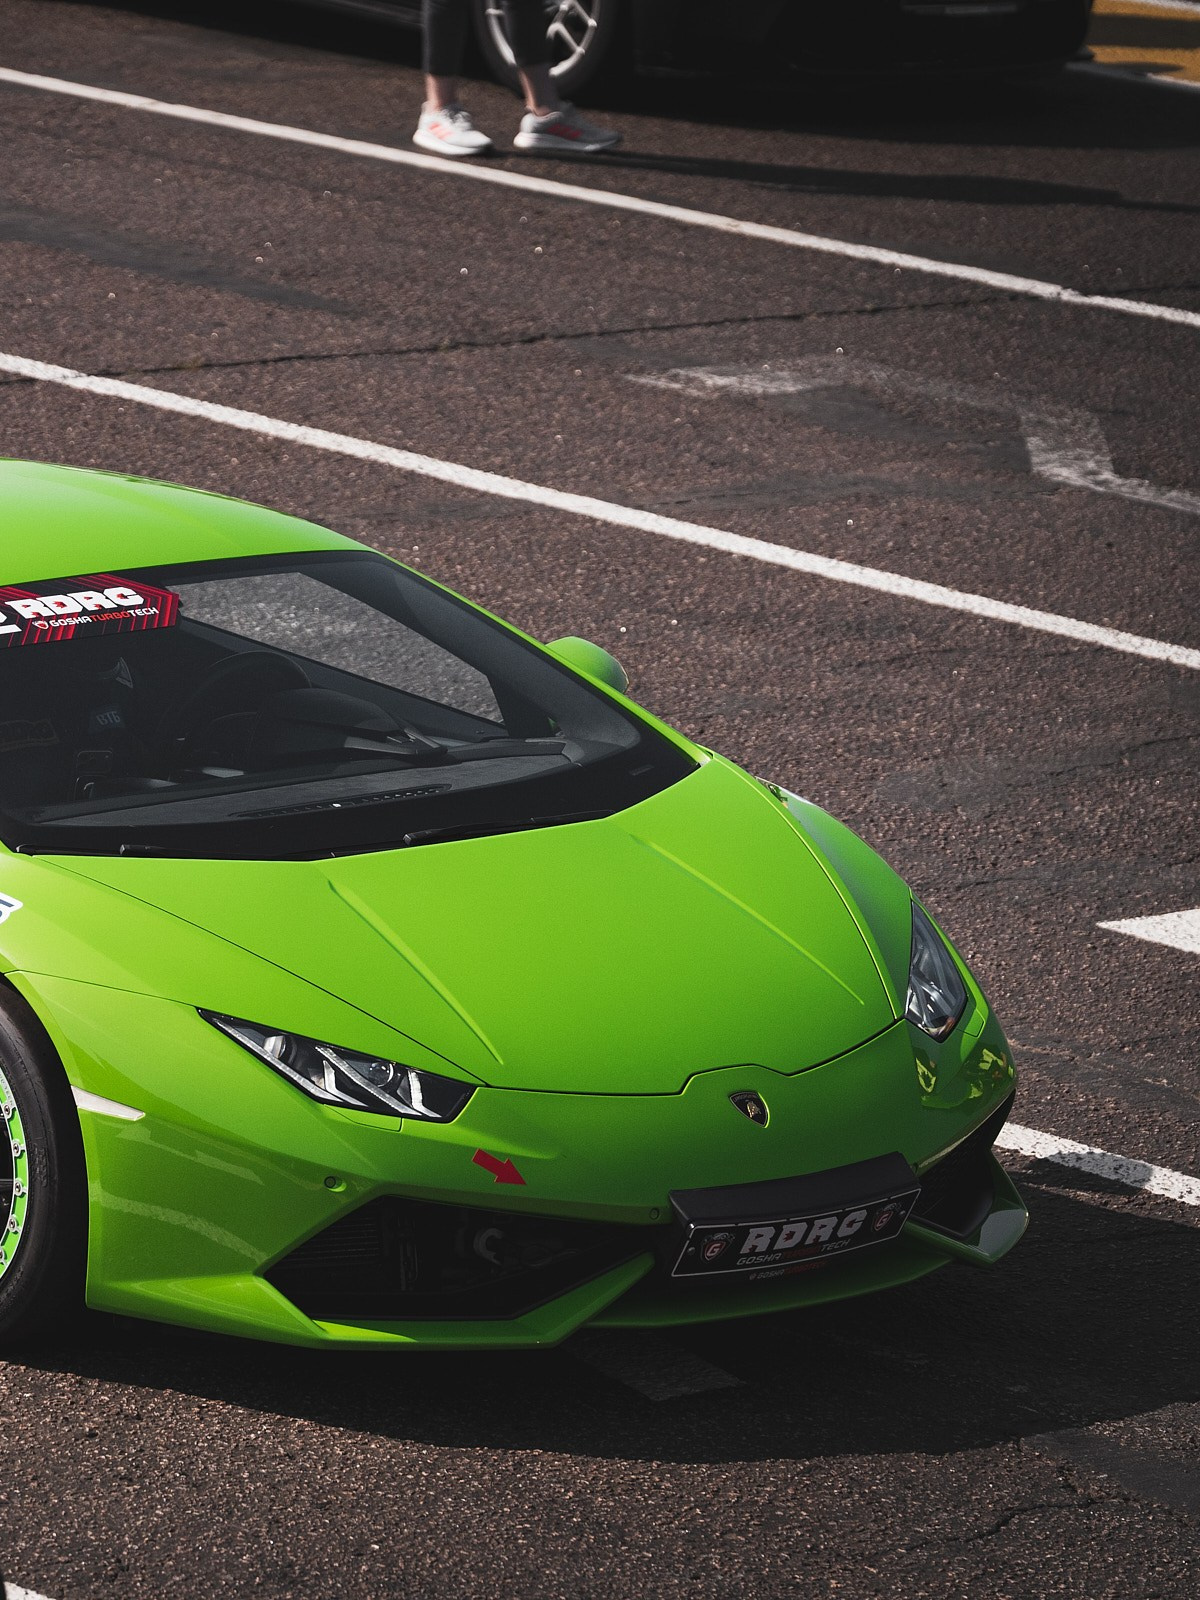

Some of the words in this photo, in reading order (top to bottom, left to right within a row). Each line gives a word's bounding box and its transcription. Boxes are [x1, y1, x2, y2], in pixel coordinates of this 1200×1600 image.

[4, 586, 145, 620] RDRC
[49, 606, 160, 629] GOSHATURBOTECH
[740, 1209, 868, 1254] RDRC
